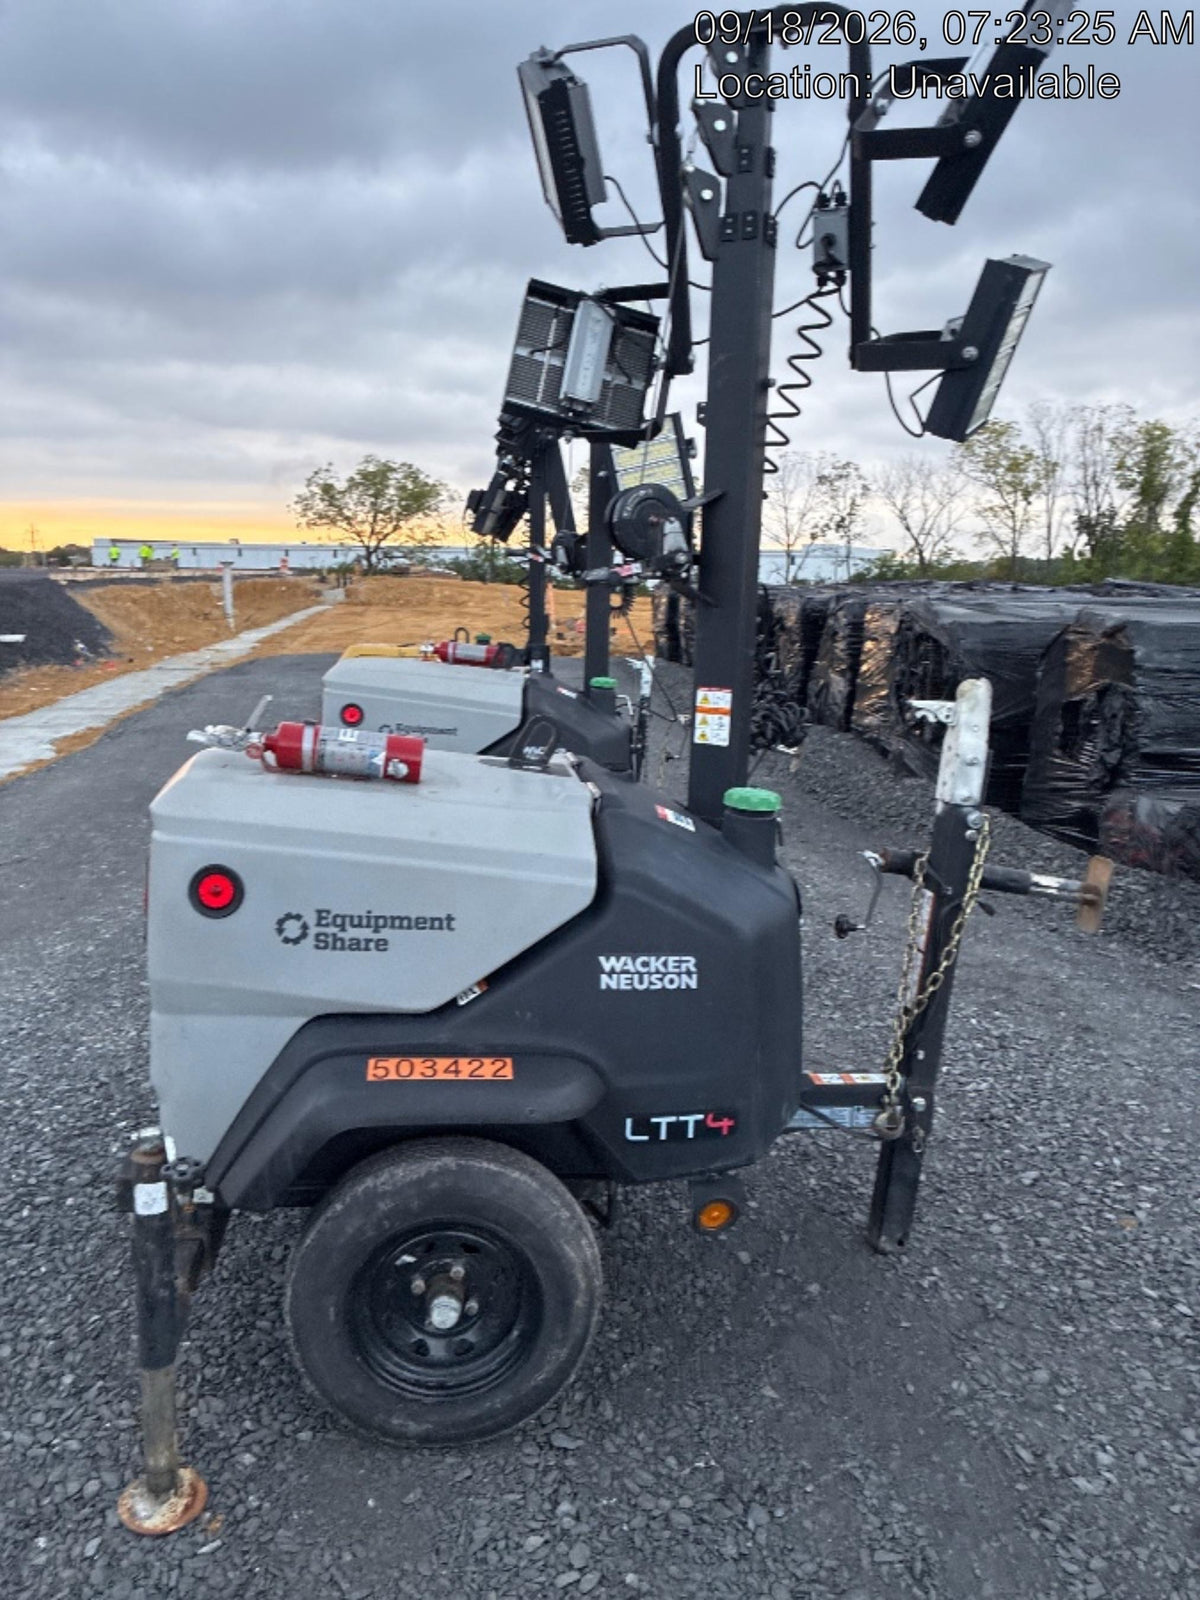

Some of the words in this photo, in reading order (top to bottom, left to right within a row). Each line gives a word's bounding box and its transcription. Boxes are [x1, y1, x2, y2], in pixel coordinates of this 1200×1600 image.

[314, 909, 456, 932] Equipment
[314, 932, 389, 952] Share
[598, 956, 697, 973] WACKER
[600, 974, 698, 990] NEUSON
[371, 1059, 510, 1080] 503422
[625, 1113, 735, 1141] LTT4
